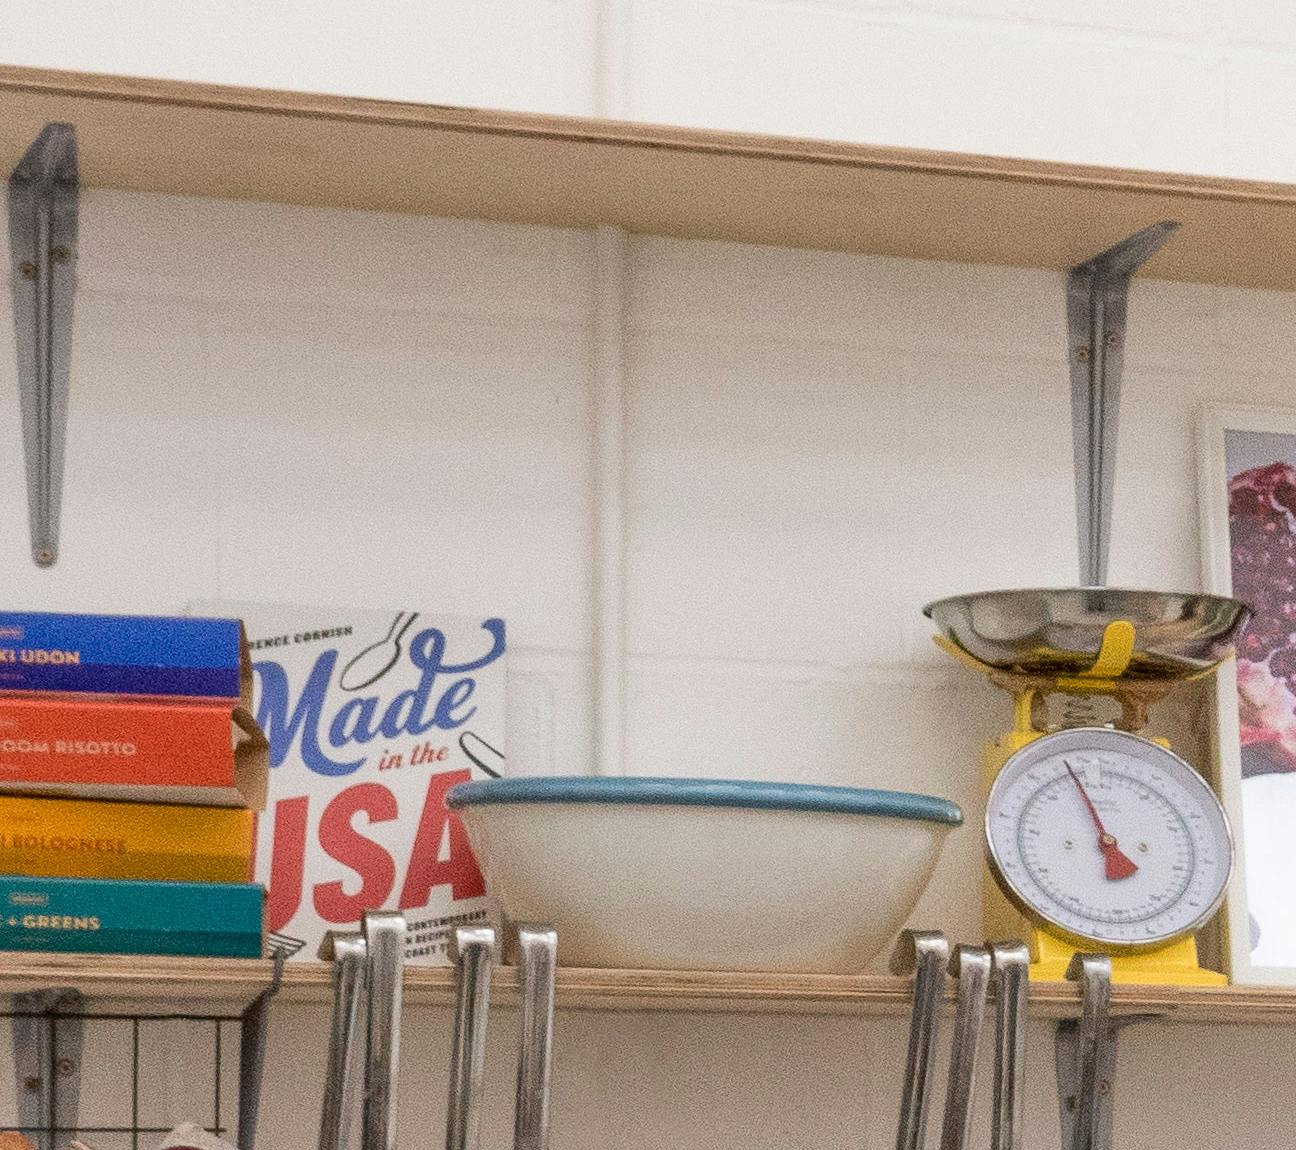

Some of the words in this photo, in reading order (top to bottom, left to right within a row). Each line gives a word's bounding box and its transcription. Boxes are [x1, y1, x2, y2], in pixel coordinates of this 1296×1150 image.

[21, 649, 80, 665] UDON
[252, 617, 507, 777] Made
[55, 739, 139, 757] RISOTTO
[378, 748, 404, 772] in
[409, 740, 449, 767] the
[13, 834, 126, 855] BOLOGNESE
[22, 914, 101, 931] GREENS
